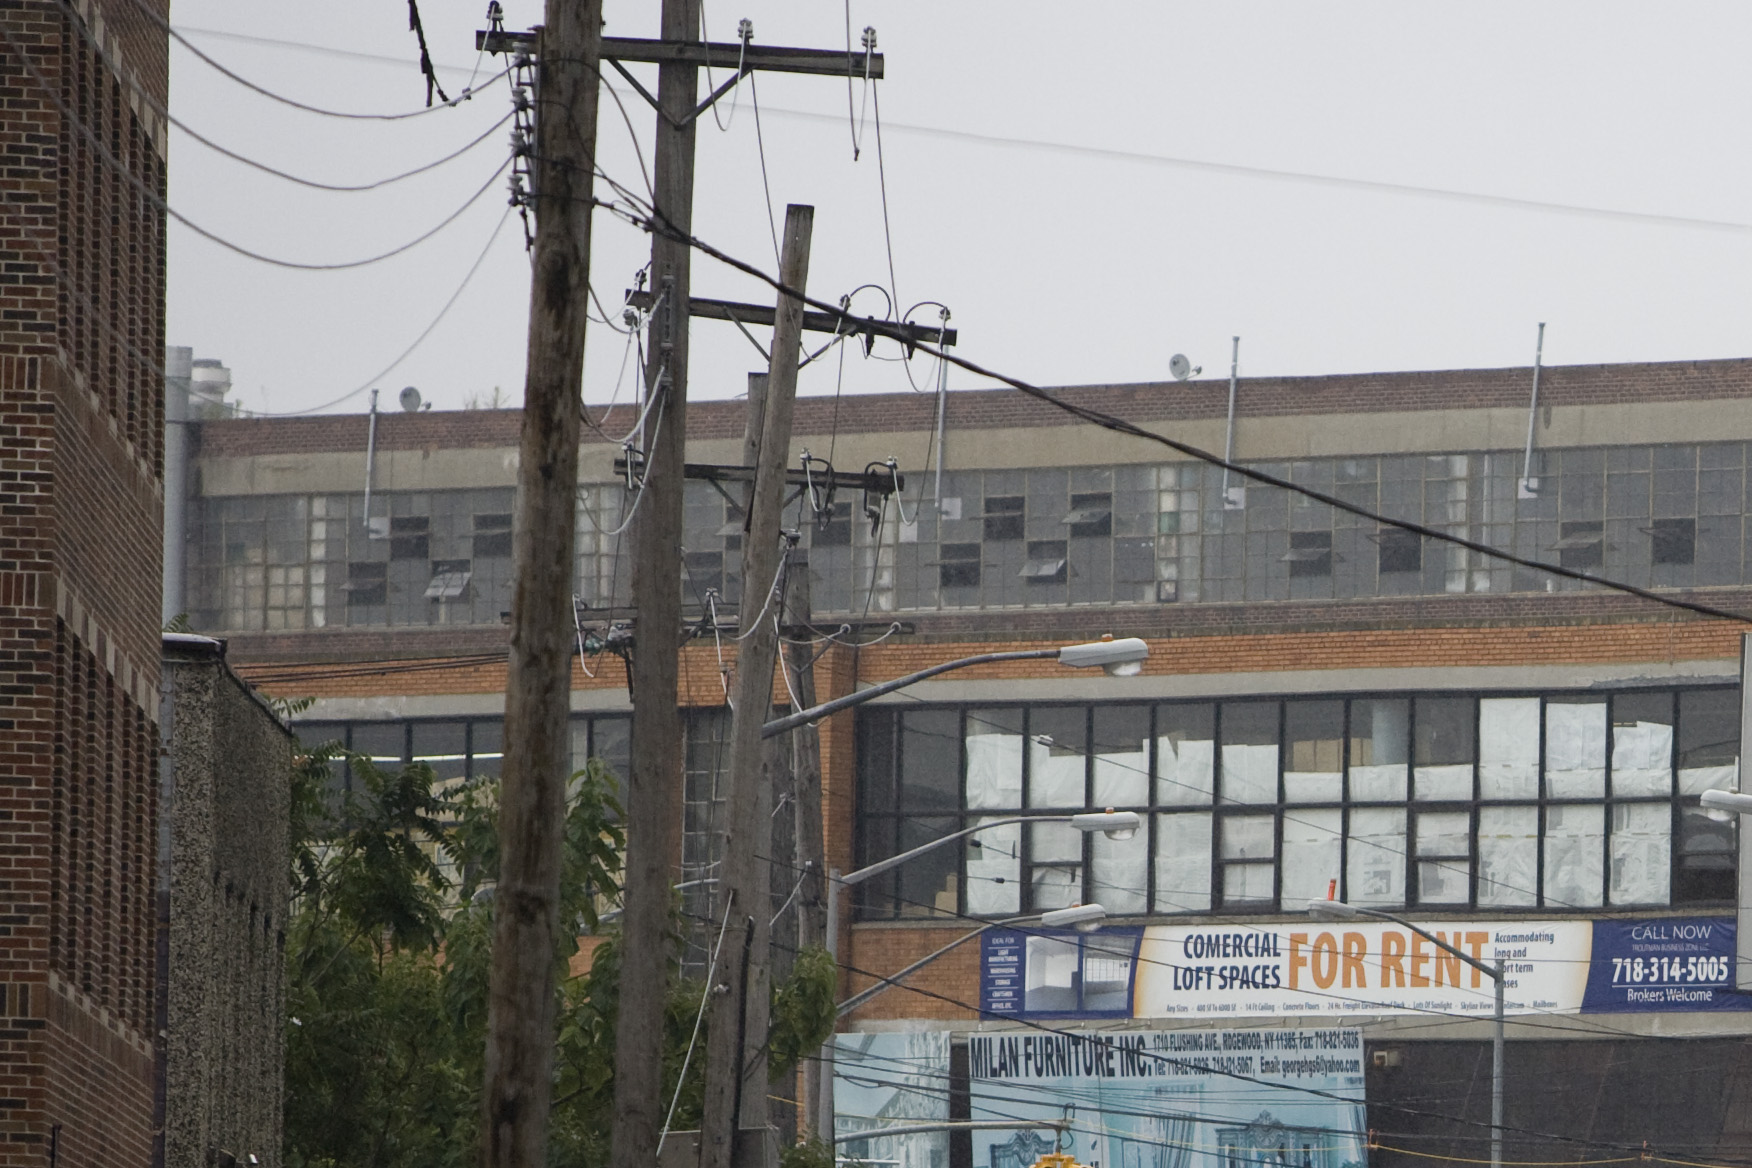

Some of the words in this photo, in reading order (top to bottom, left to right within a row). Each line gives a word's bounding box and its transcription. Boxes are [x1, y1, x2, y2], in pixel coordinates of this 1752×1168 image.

[1494, 930, 1555, 944] Accommodating
[1631, 925, 1669, 940] CALL
[1673, 925, 1712, 939] NOW
[1183, 932, 1281, 959] COMERCIAL
[1494, 947, 1511, 960] long
[1512, 947, 1527, 958] and
[1288, 931, 1368, 991] FOR
[1380, 930, 1490, 989] RENT
[1515, 963, 1534, 973] term
[1611, 955, 1729, 983] 718-314-5005
[1173, 964, 1214, 991] LOFT
[1218, 964, 1281, 990] SPACES
[1627, 987, 1665, 1002] Brokers
[1665, 987, 1713, 1002] Welcome
[1169, 1032, 1203, 1051] FLUSHING
[1264, 1032, 1274, 1050] NY
[970, 1035, 1020, 1078] MILAN
[1023, 1034, 1116, 1078] FURNITURE
[1119, 1034, 1152, 1077] INC.
